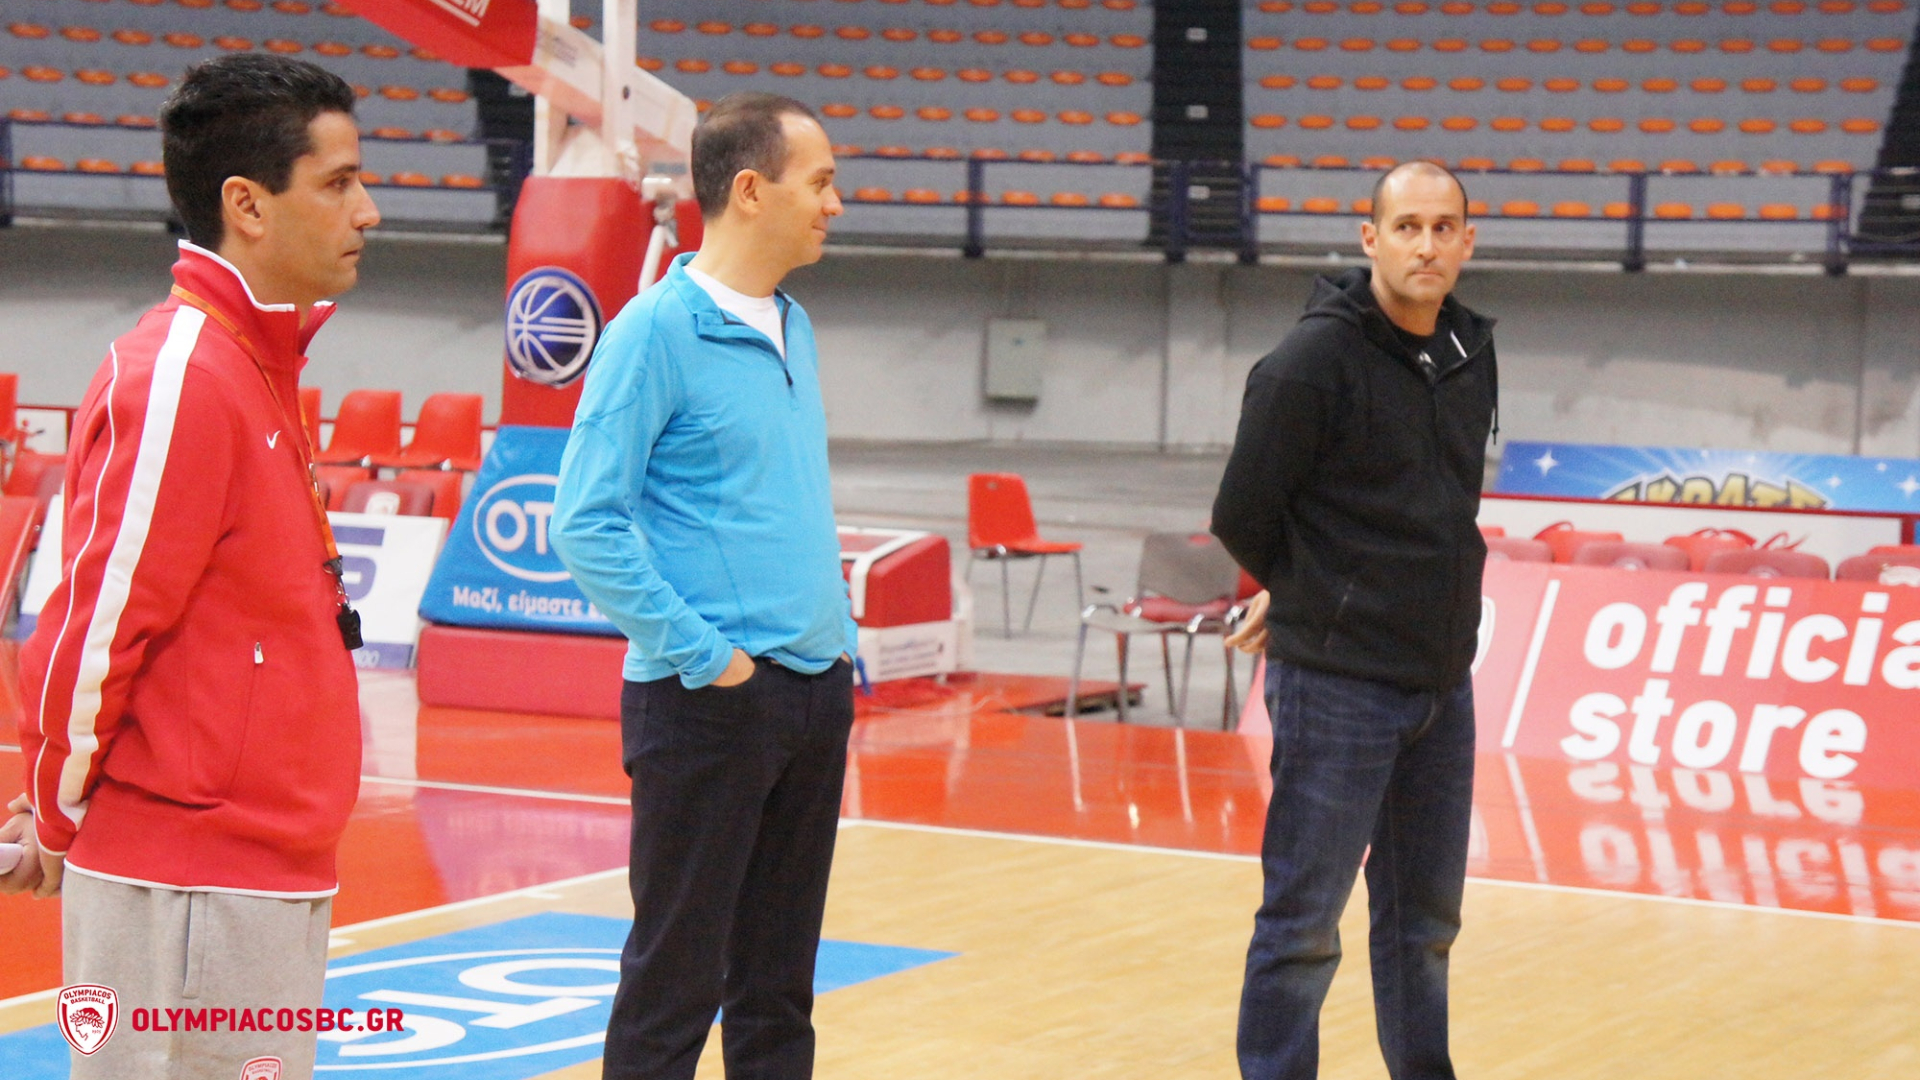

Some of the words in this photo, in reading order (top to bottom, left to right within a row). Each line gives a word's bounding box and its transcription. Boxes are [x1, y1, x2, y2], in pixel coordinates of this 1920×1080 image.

[485, 499, 554, 556] ΟΤ
[1583, 582, 1920, 690] officia
[1560, 678, 1868, 779] store
